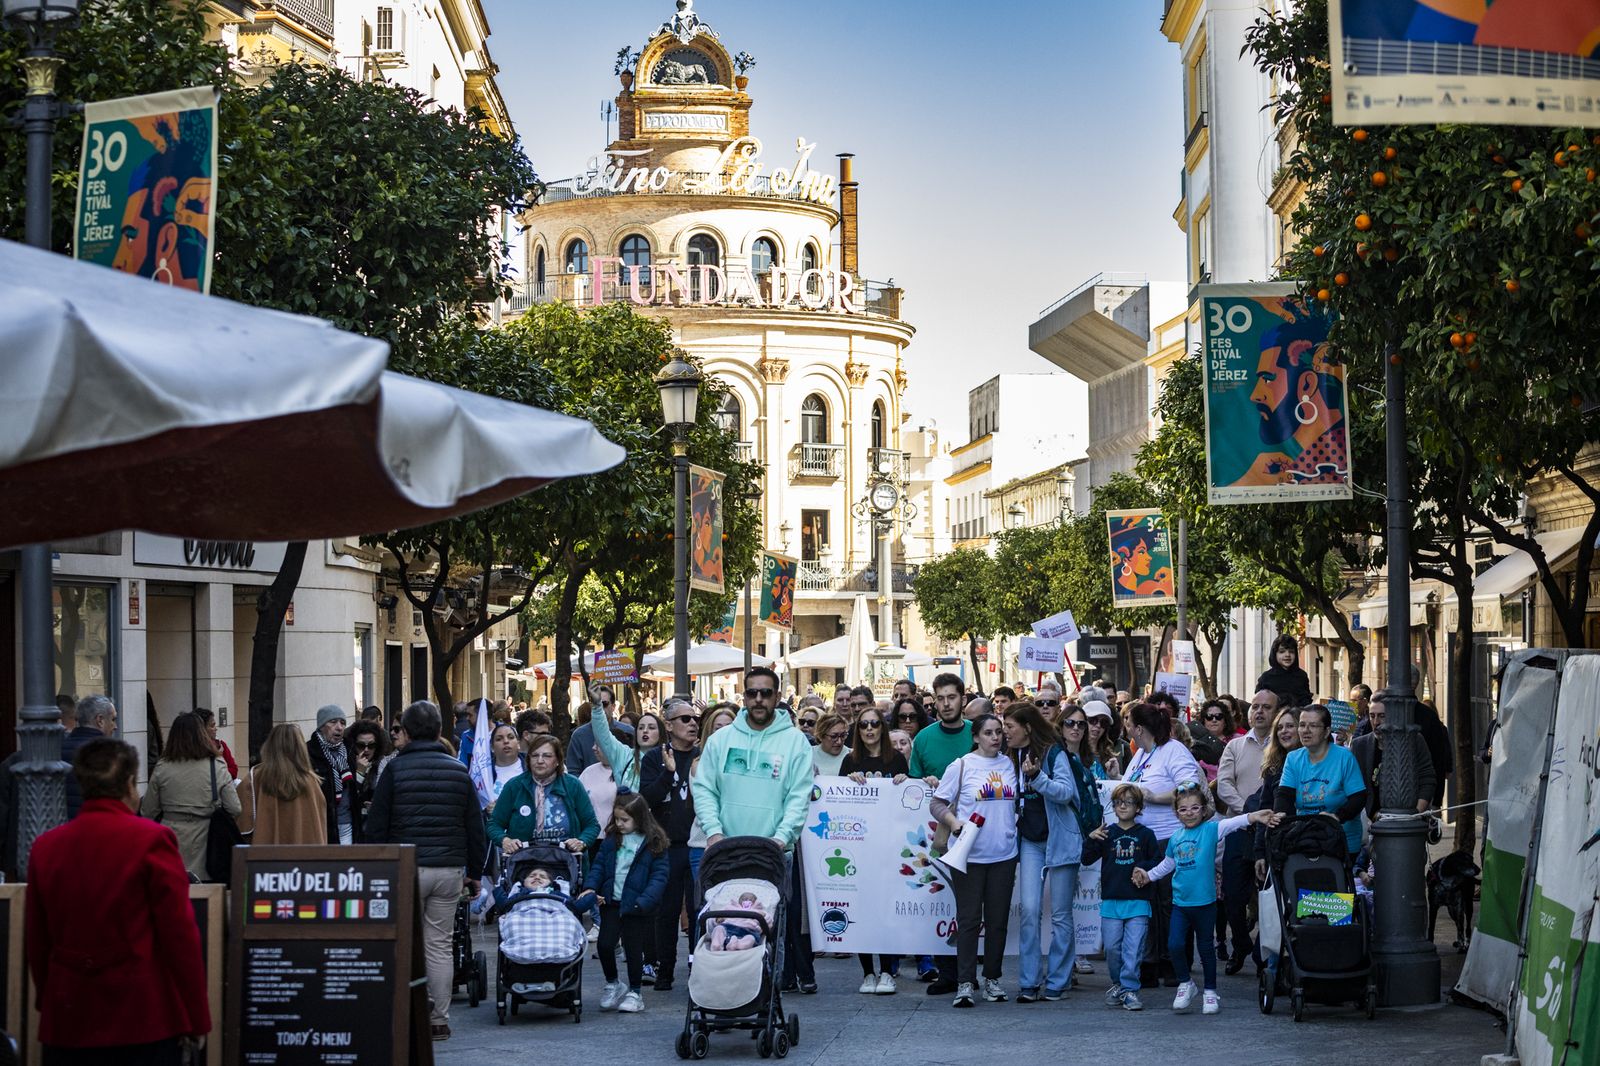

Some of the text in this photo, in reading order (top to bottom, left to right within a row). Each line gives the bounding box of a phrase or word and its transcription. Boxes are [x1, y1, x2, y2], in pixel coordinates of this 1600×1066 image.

[88, 130, 127, 178] 30
[571, 148, 674, 195] Fino
[683, 136, 763, 195] La
[86, 180, 106, 196] FES
[86, 195, 112, 211] TIVAL
[84, 212, 98, 226] DE
[83, 225, 115, 242] JEREZ
[593, 257, 855, 314] FUNDADOR
[1209, 302, 1253, 336] 30
[1211, 338, 1232, 348] FES
[1211, 349, 1241, 359] TIVAL
[1212, 360, 1227, 370] DE
[1212, 370, 1248, 380] JEREZ
[764, 556, 775, 569] 30
[827, 786, 879, 796] ANSEDH
[255, 867, 301, 892] MENÚ
[305, 872, 334, 892] DEL
[339, 867, 363, 892] DÍA
[895, 901, 951, 916] RARAS PERO
[1303, 900, 1348, 910] MARAVILLOSO
[321, 1032, 351, 1046] MENU
